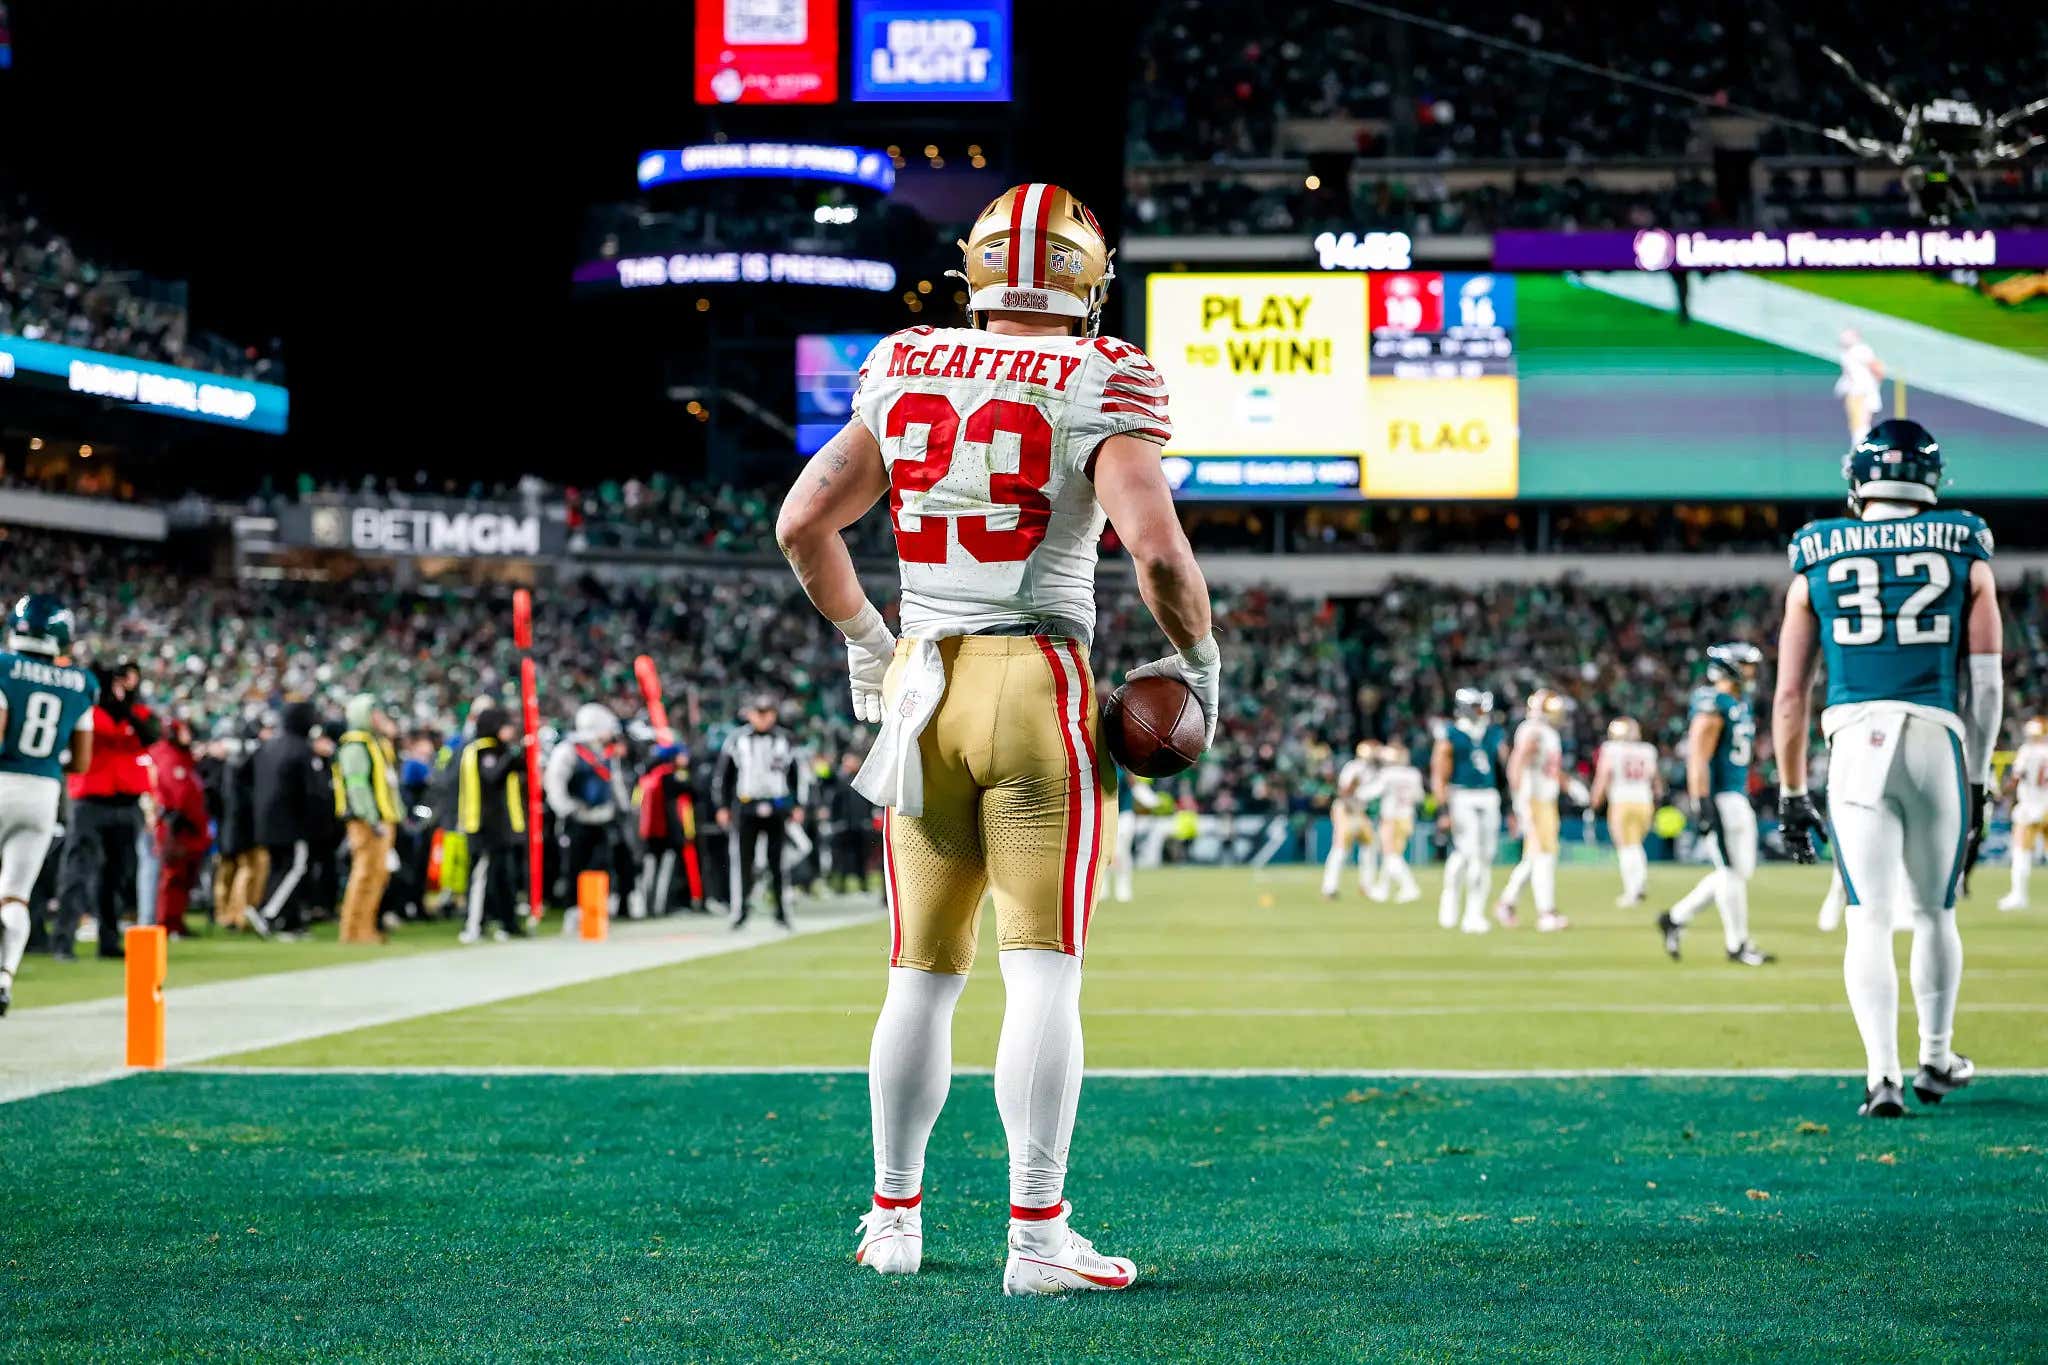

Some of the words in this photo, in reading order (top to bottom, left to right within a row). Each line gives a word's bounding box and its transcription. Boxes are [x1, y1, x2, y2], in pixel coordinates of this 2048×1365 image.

[887, 20, 976, 50] BUD
[871, 48, 992, 83] LIGHT
[1676, 232, 1786, 267] Lincoln
[1787, 231, 1920, 266] Financial
[1921, 231, 1995, 266] Field
[616, 256, 667, 288] THIS
[668, 253, 740, 284] GAME
[741, 253, 768, 283] IS
[1002, 290, 1048, 310] 49ERS
[1202, 294, 1312, 331] PLAY
[886, 342, 1081, 391] McCAFFREY
[1225, 336, 1333, 375] WIN!
[1387, 419, 1491, 453] FLAG
[886, 392, 1053, 564] 23
[352, 507, 540, 555] BETMGM
[1800, 521, 1970, 567] BLANKENSHIP
[1828, 552, 1950, 645] 32
[18, 691, 62, 758] 8
